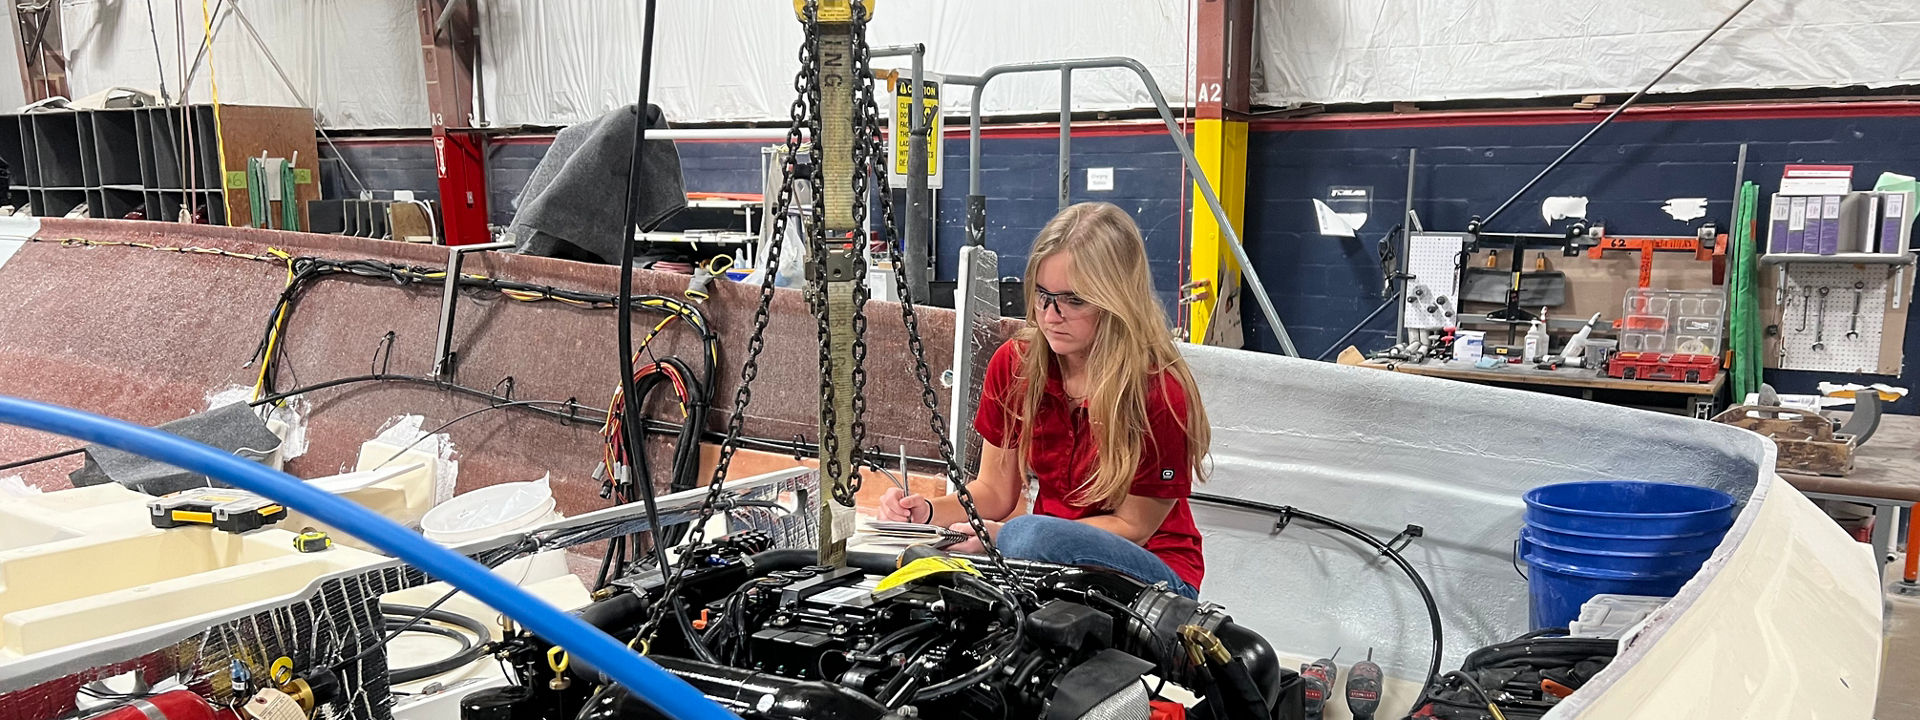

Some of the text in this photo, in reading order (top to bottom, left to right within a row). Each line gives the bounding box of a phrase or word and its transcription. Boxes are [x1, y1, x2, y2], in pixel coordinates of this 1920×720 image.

[907, 85, 936, 97] CION
[1198, 82, 1222, 102] A2
[431, 112, 443, 126] A3
[1611, 239, 1627, 248] 62
